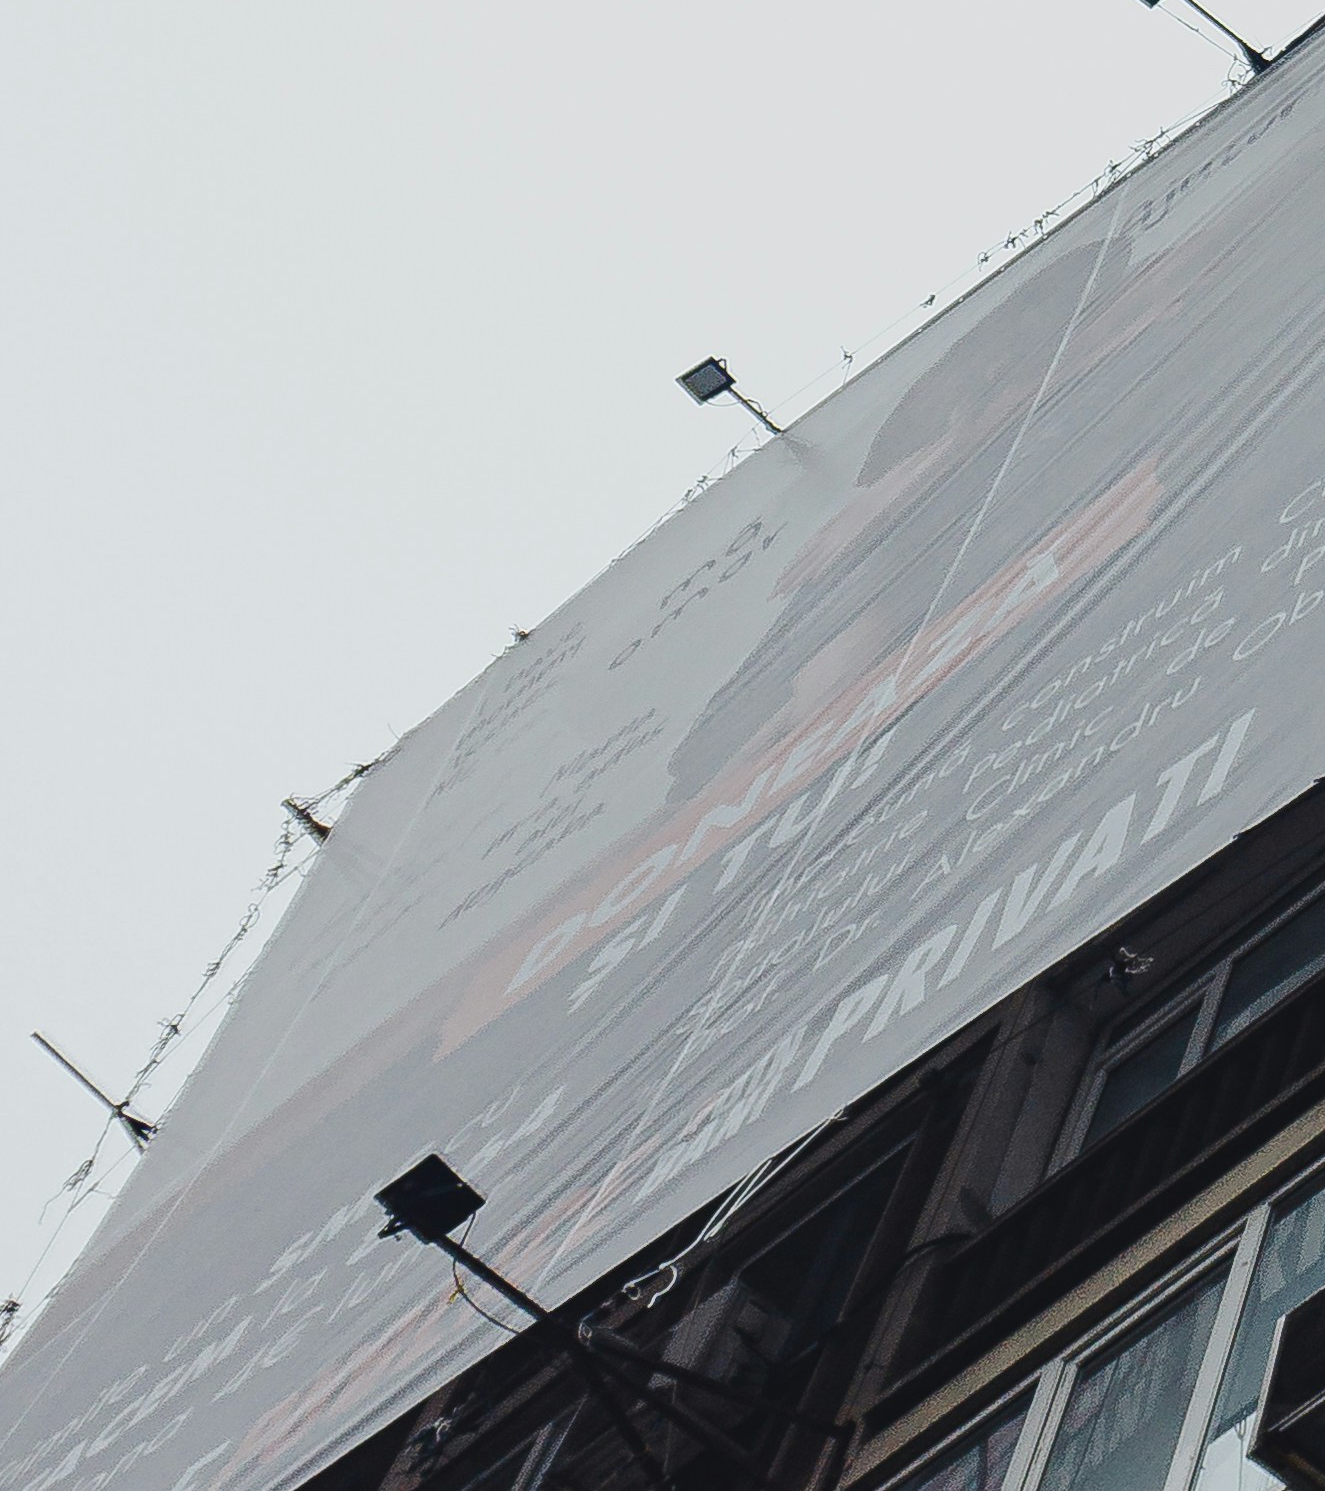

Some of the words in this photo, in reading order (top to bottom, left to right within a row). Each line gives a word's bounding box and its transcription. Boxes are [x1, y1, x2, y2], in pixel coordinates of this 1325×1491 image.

[962, 585, 1223, 793] Pediatrică
[965, 705, 1113, 820] Clinic
[1165, 616, 1235, 675] de
[1000, 545, 1242, 731] construim
[505, 549, 1062, 995] DONEAZĂ
[909, 675, 1202, 900] Alexandru
